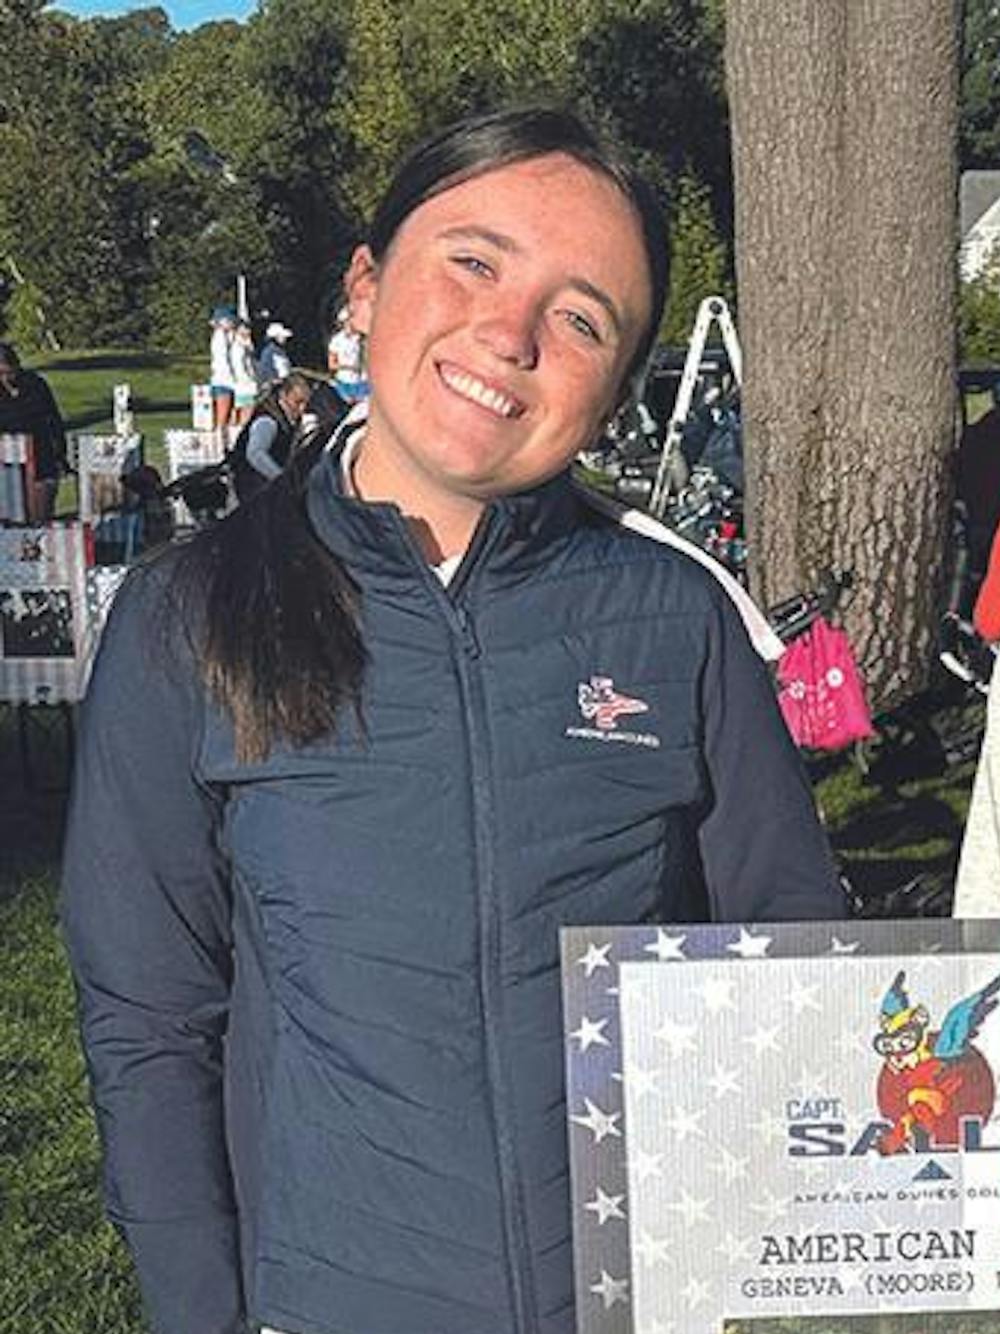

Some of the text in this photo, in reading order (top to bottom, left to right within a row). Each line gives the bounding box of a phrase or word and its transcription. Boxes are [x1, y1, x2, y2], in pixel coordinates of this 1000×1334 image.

[758, 1229, 977, 1265] AMERICAN
[740, 1274, 846, 1300] GENEVA
[863, 1270, 976, 1296] (MOORE)
